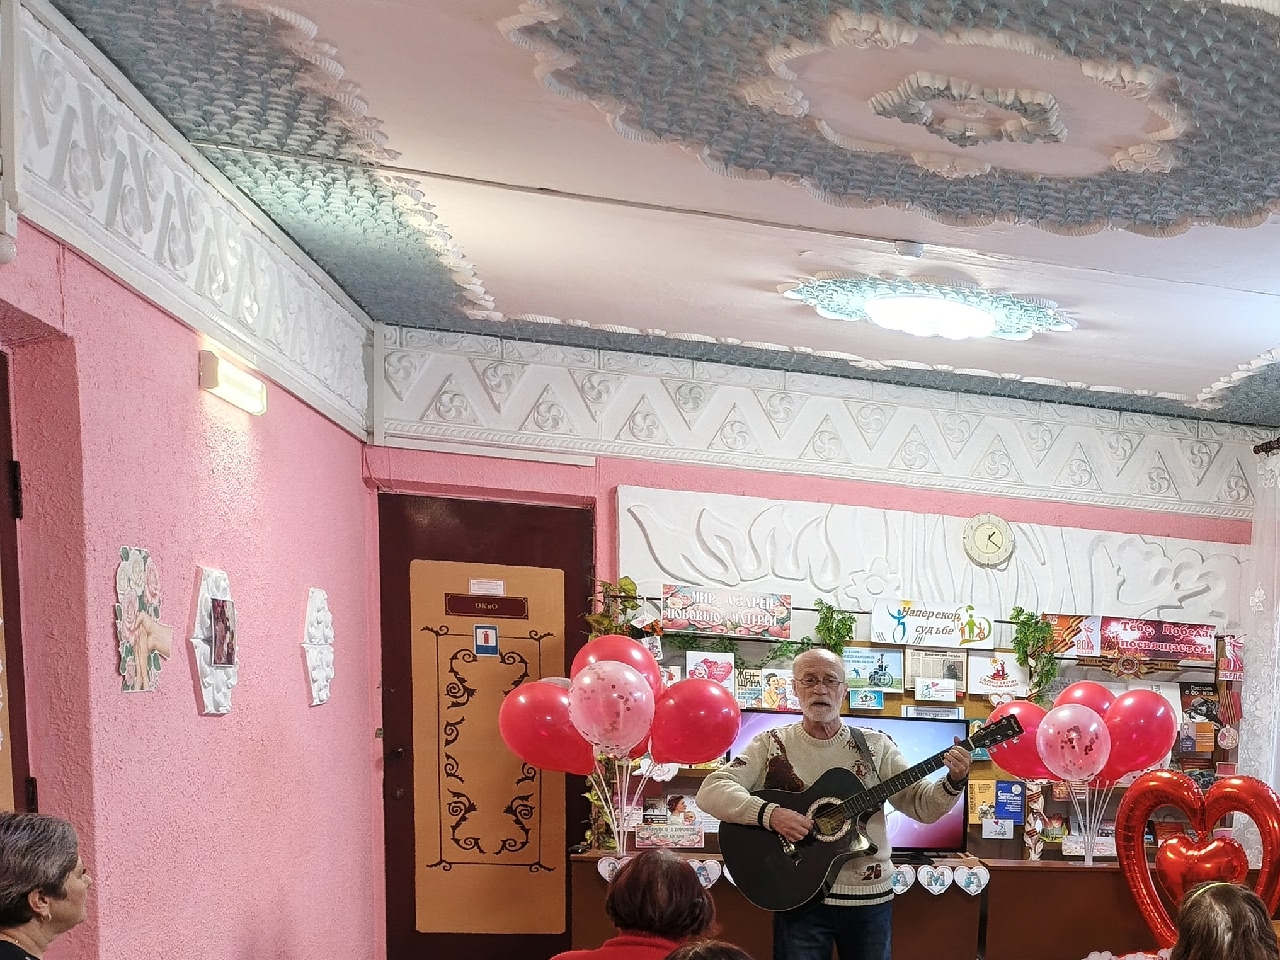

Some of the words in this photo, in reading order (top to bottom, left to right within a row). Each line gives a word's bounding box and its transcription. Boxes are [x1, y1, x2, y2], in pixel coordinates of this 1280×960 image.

[692, 591, 716, 604] МИР
[901, 606, 962, 622] Наперекор
[915, 625, 954, 635] судьбе
[1120, 621, 1155, 637] Тебе,
[1162, 624, 1212, 639] Победа,
[1120, 640, 1212, 655] посвящается!
